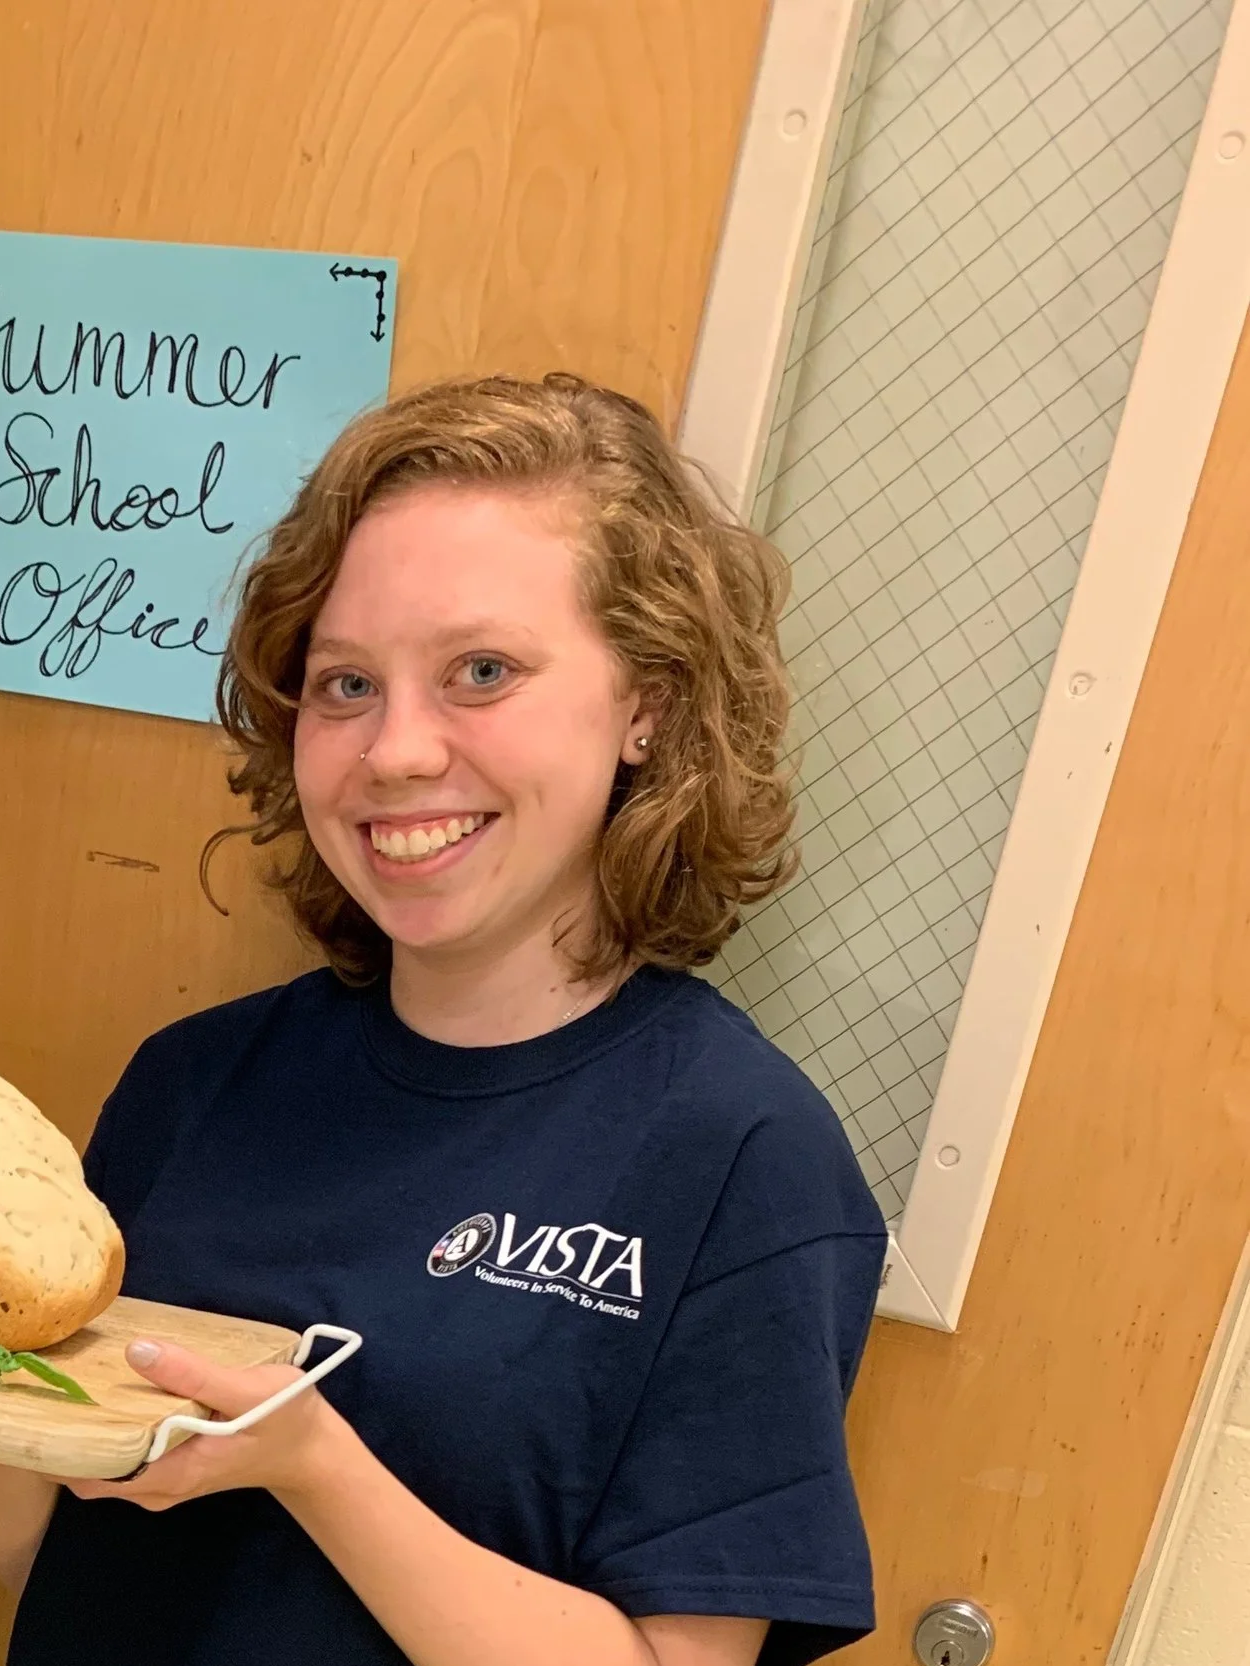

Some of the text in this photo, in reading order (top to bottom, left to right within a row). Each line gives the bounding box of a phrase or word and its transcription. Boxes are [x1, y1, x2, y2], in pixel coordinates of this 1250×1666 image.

[496, 1212, 643, 1298] VISTA
[474, 1265, 641, 1321] Volunteers In Service To America
